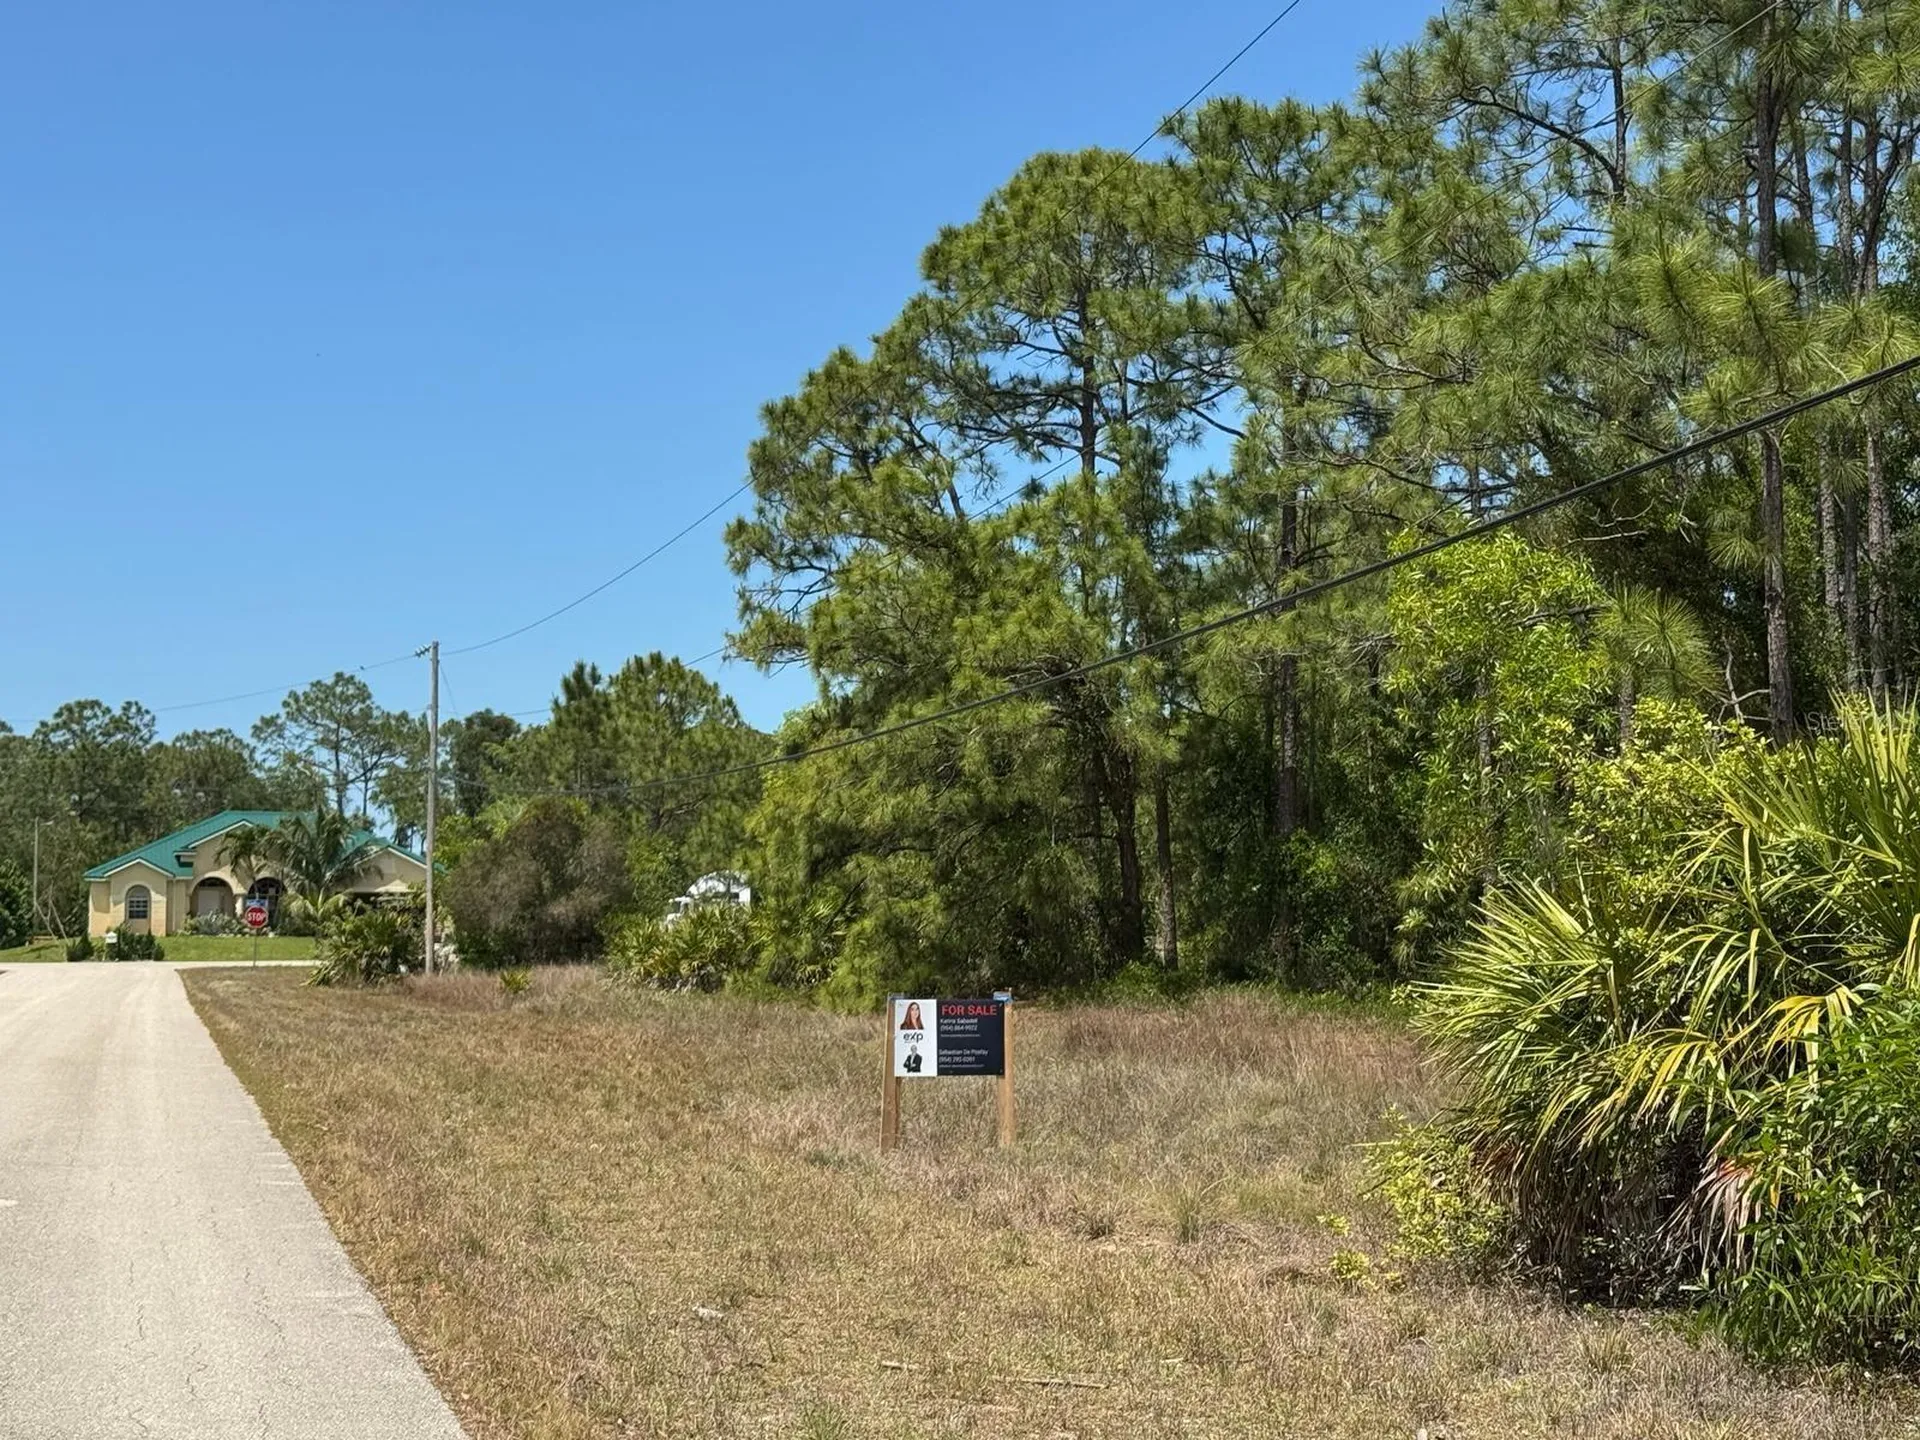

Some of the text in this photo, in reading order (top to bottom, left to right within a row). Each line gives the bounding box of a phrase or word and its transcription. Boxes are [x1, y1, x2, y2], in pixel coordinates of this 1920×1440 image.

[247, 912, 266, 922] STOP
[941, 1004, 997, 1016] FOR SALE
